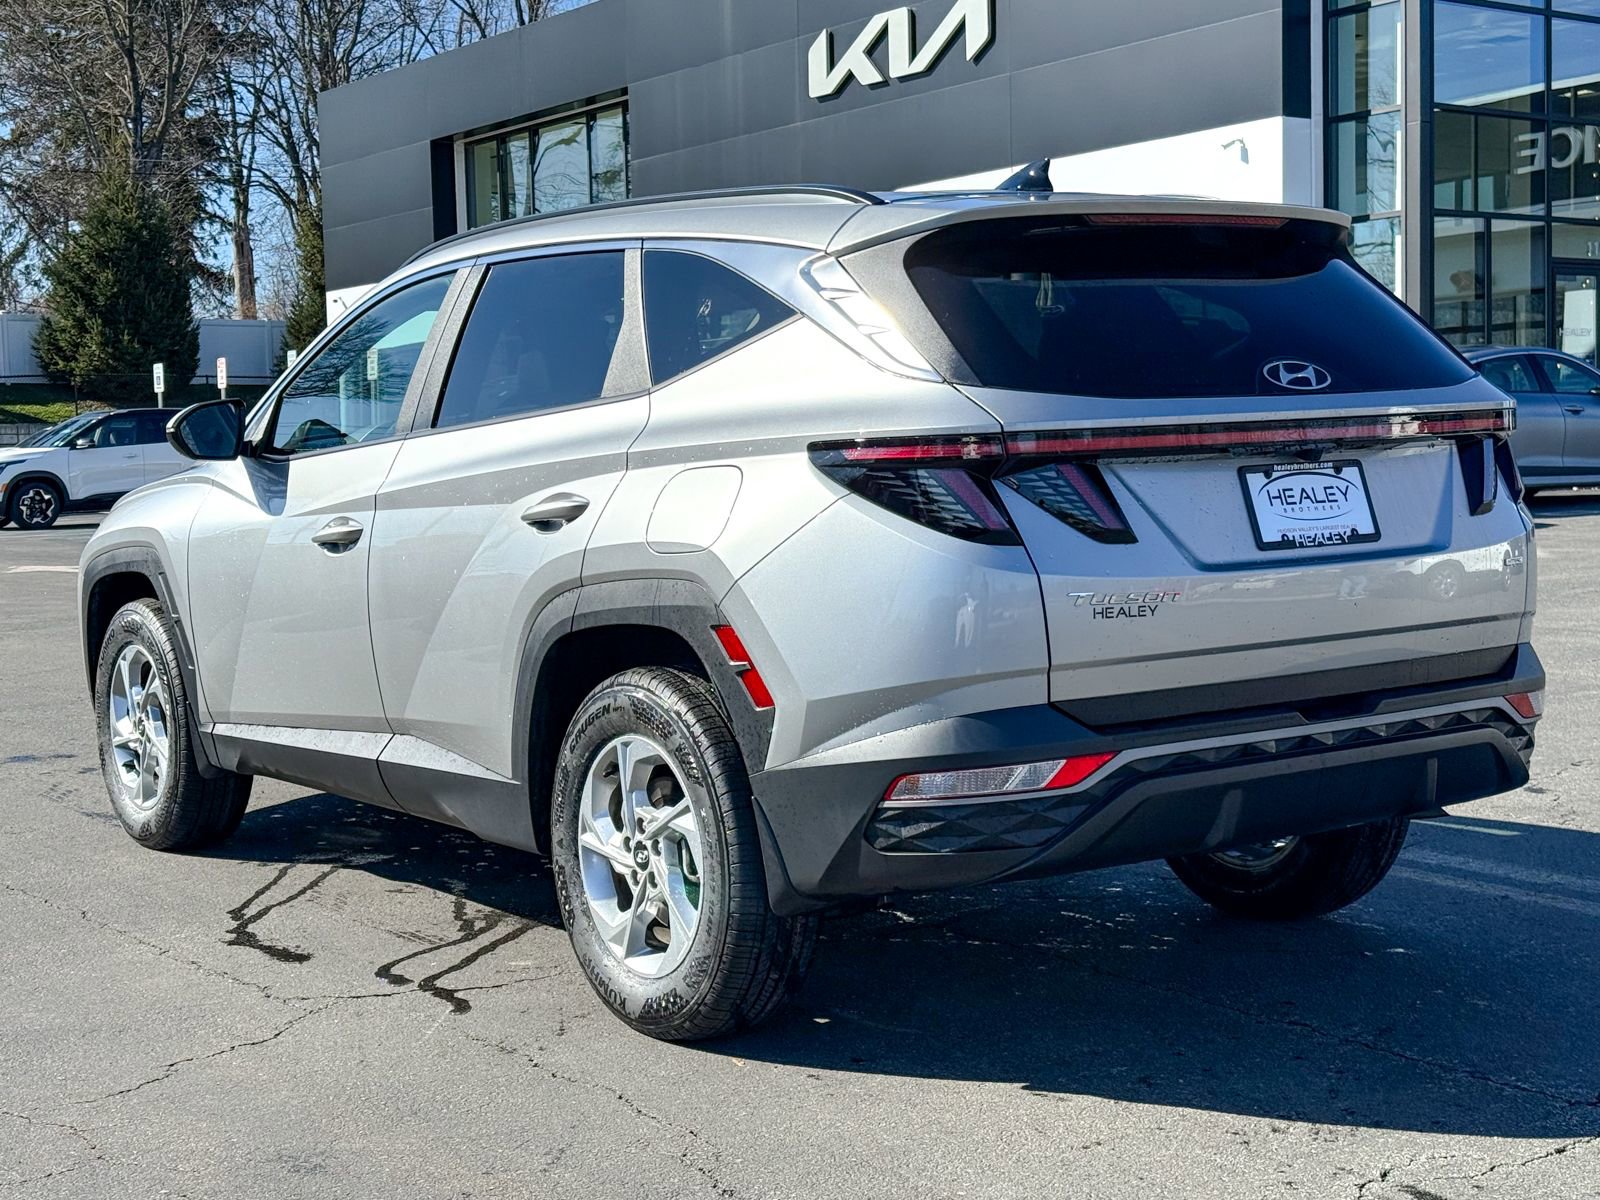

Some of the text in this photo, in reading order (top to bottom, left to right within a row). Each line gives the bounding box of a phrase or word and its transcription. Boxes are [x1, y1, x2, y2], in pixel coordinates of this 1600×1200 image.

[808, 0, 990, 98] KIA
[1558, 327, 1592, 337] HEALEY
[1273, 461, 1334, 472] healeybrothers.com
[1266, 485, 1350, 506] HEALEY
[1295, 531, 1349, 547] HEALEY
[1066, 591, 1181, 607] TUCSON
[1093, 605, 1158, 619] HEALEY
[569, 703, 611, 755] CRUGEN
